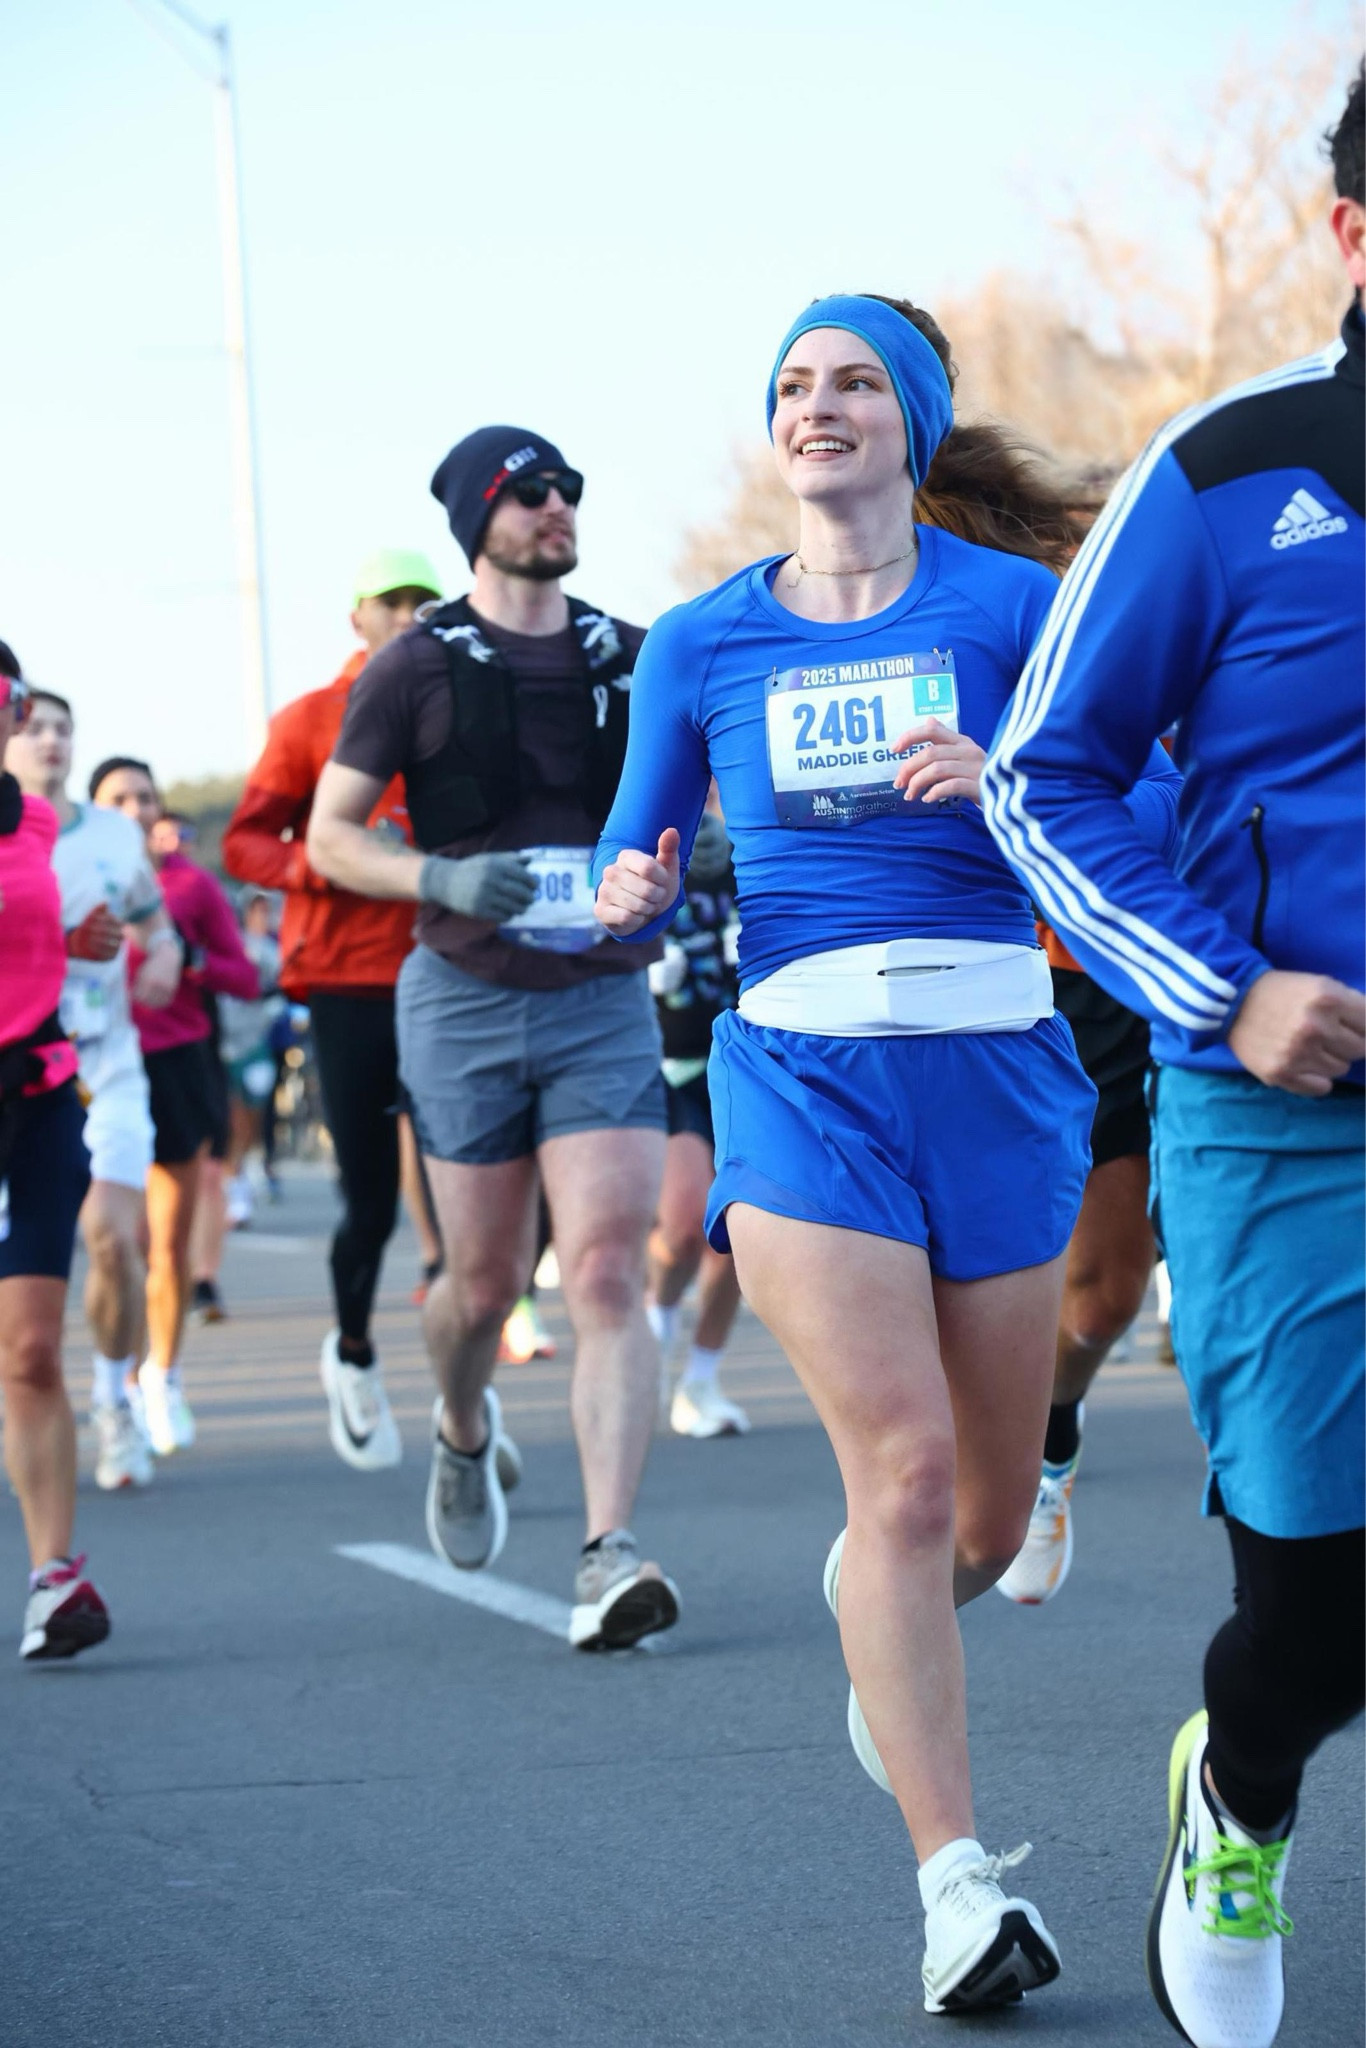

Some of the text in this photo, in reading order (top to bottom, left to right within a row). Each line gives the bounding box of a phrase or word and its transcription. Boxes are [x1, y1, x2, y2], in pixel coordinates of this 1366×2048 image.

[1270, 516, 1348, 550] adidas
[801, 657, 915, 687] 2025 MARATHON
[927, 679, 940, 702] B
[793, 695, 886, 751] 2461
[797, 750, 868, 771] MADDIE
